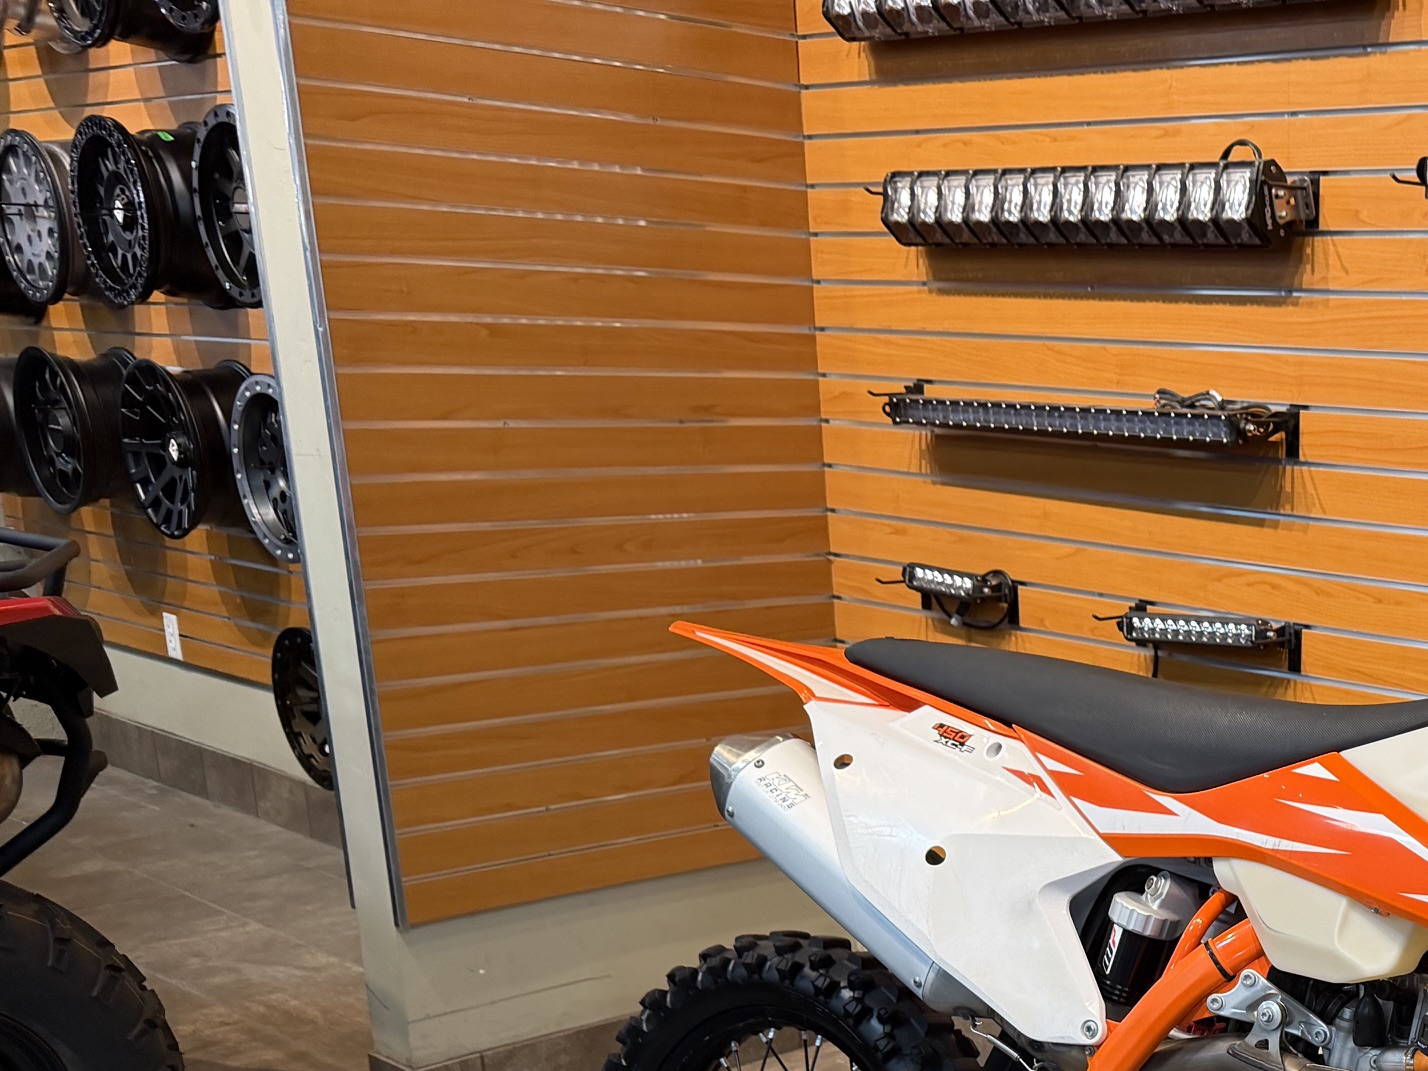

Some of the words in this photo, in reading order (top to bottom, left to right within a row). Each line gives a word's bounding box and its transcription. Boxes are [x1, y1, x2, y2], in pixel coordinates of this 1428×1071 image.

[932, 722, 974, 744] 450
[933, 737, 976, 754] XC-F
[757, 776, 796, 809] RACING
